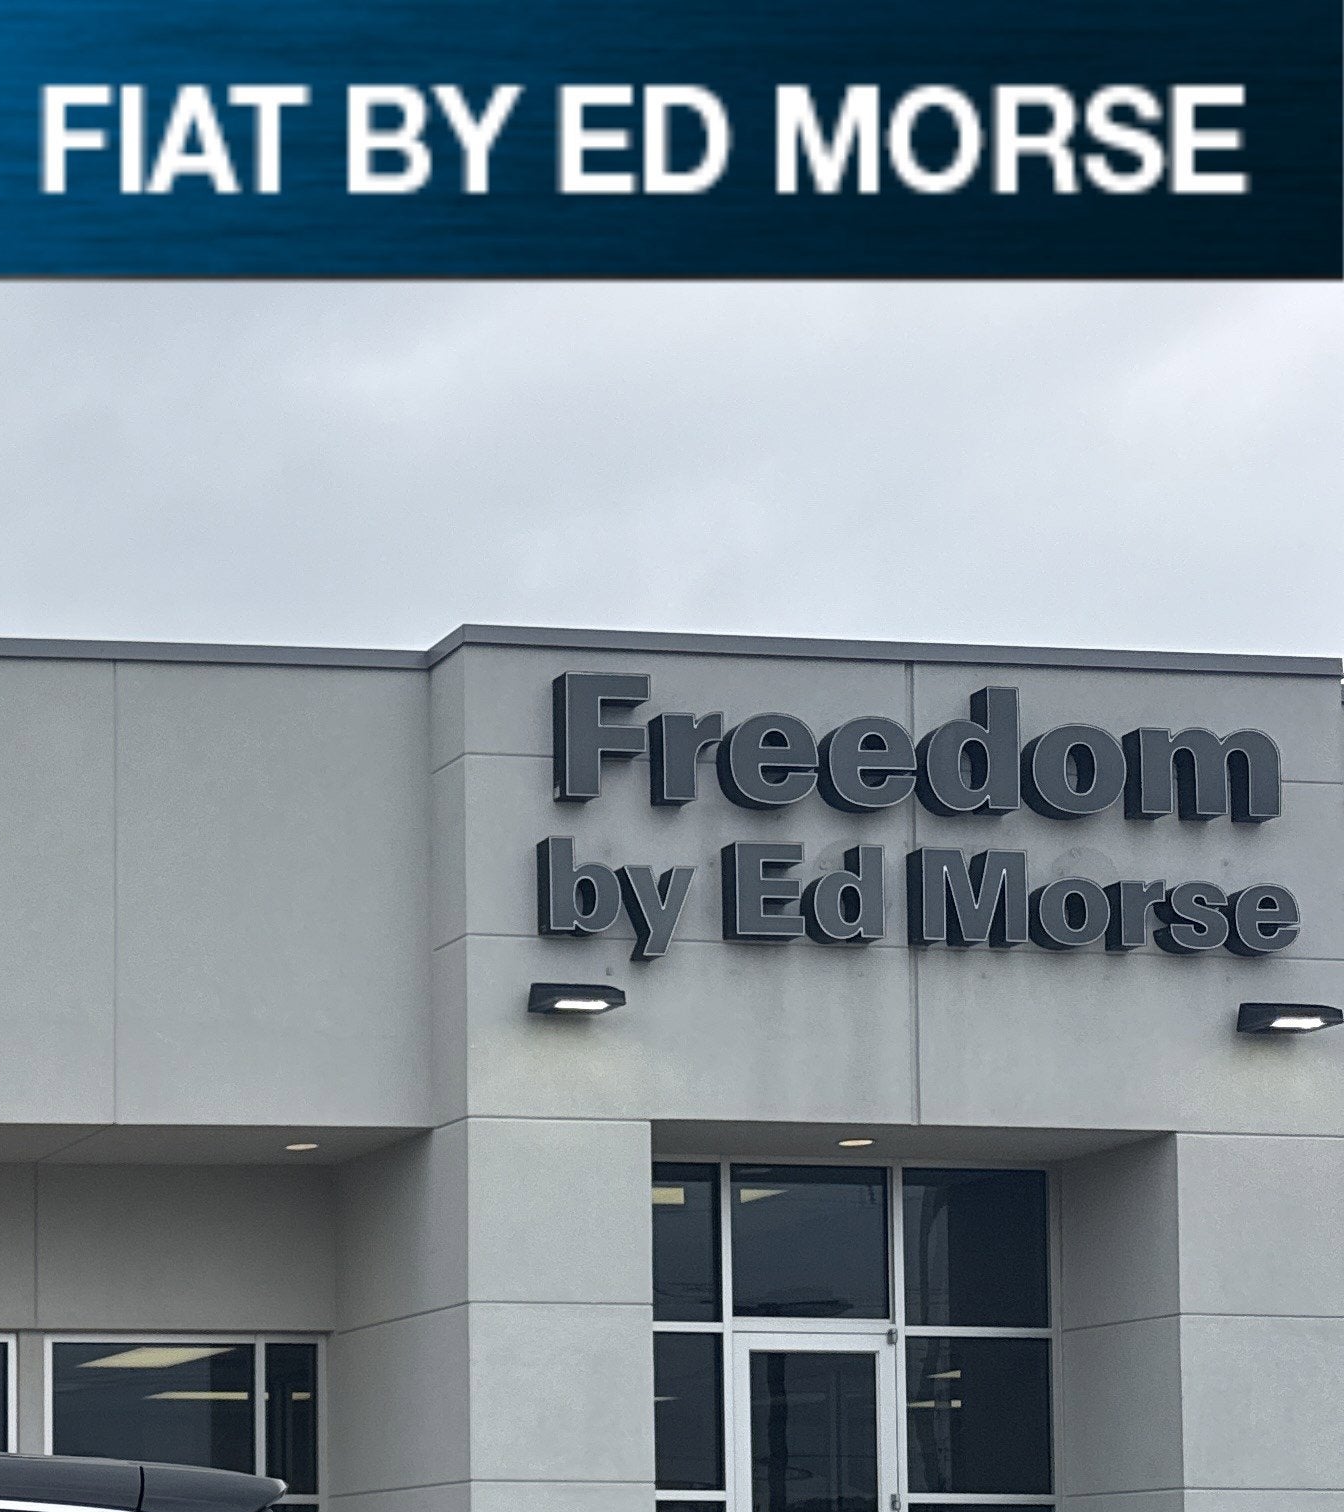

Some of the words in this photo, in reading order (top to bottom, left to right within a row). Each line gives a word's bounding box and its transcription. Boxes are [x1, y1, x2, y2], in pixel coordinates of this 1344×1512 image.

[552, 670, 1283, 823] Freedom
[536, 835, 699, 961] by
[721, 840, 887, 941] Ed
[906, 845, 1302, 957] Morse
